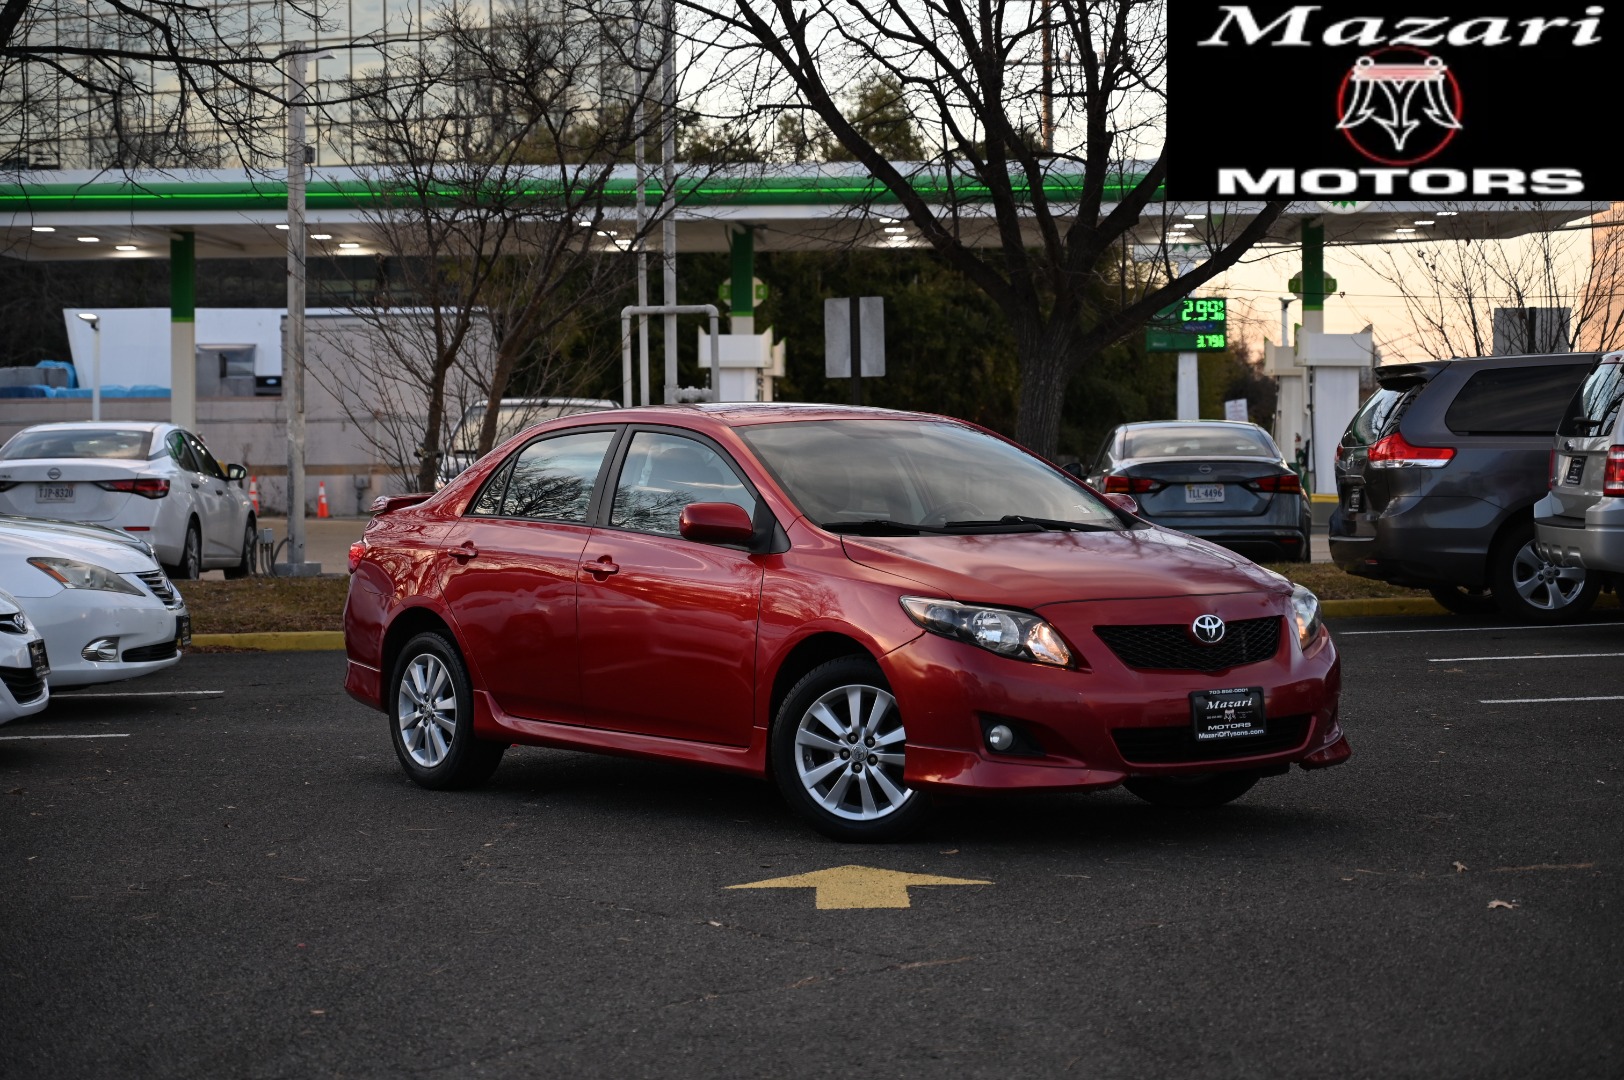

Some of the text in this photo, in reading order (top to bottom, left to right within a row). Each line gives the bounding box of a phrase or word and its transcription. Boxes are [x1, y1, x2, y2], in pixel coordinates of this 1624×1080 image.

[39, 488, 74, 498] TJP-8320
[1189, 488, 1223, 499] TLL-4496
[1206, 698, 1253, 710] Mazari
[1207, 722, 1252, 731] MOTORS
